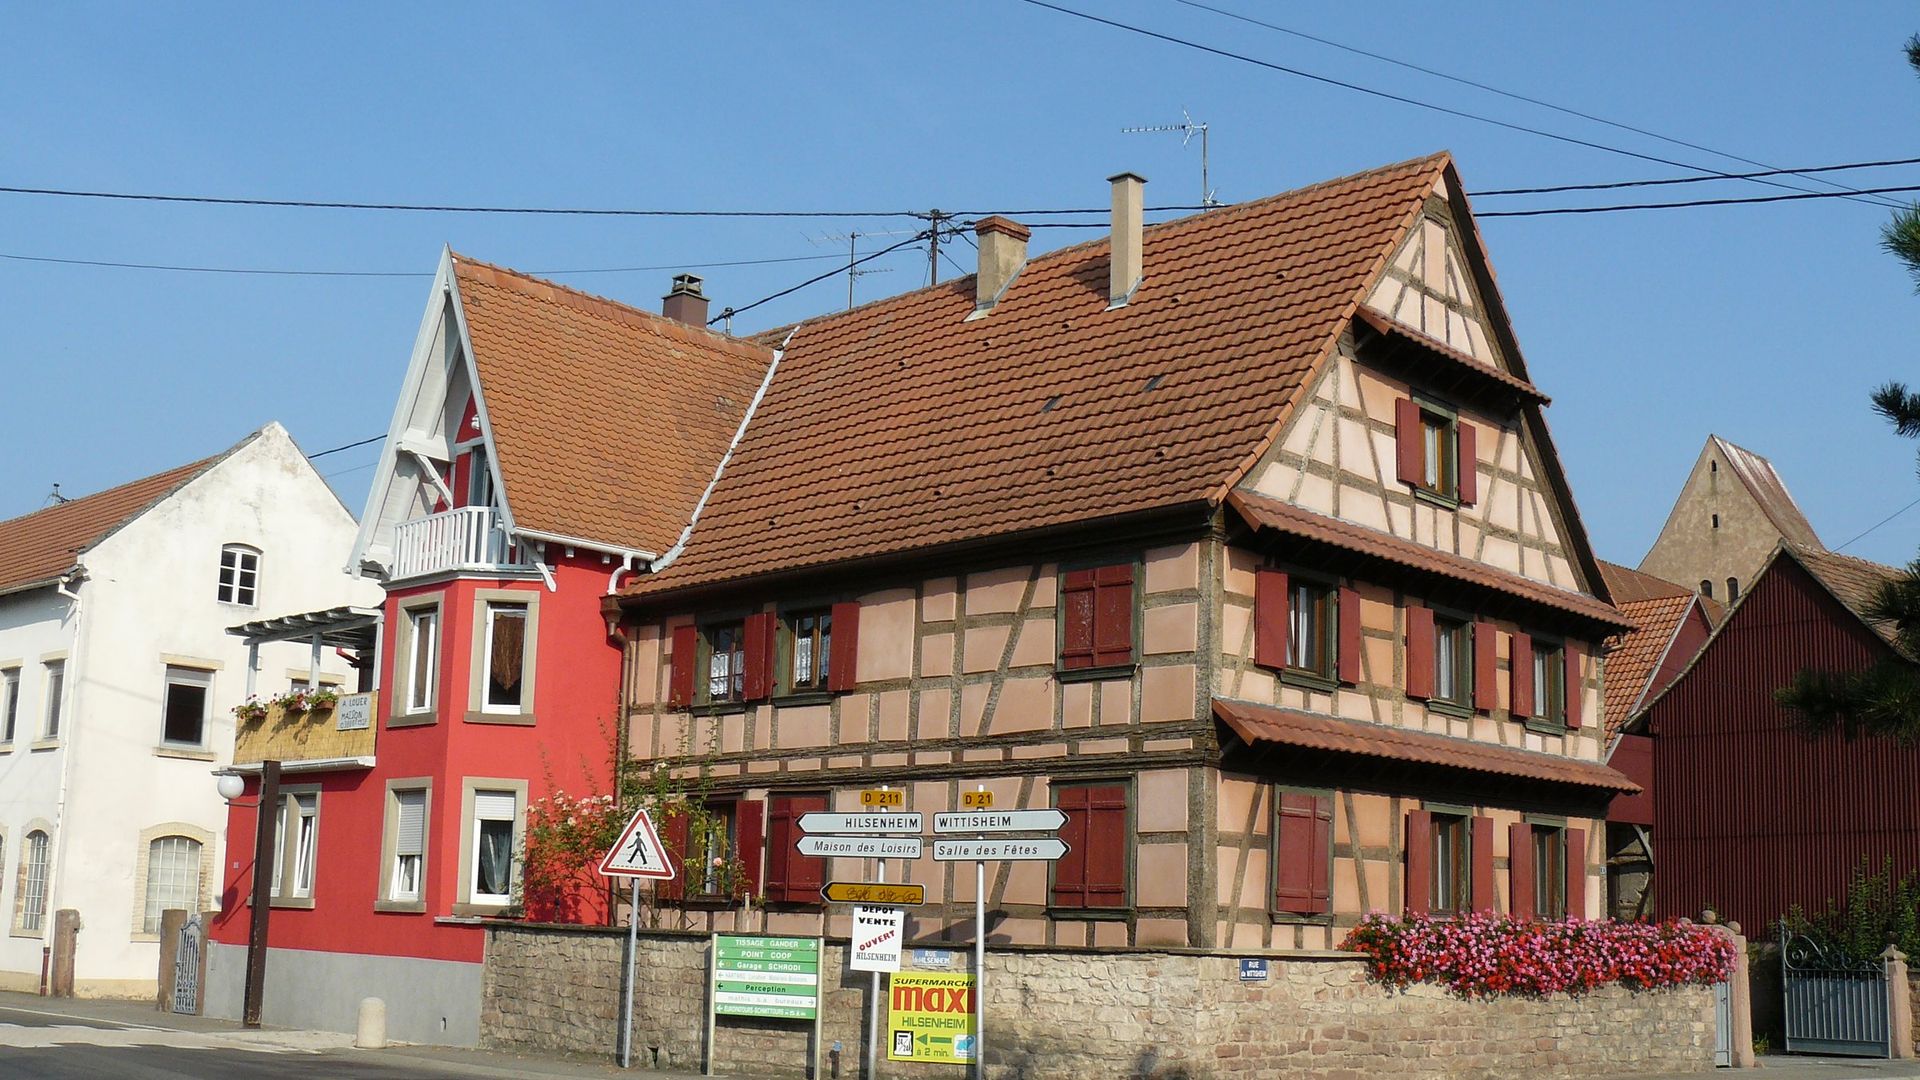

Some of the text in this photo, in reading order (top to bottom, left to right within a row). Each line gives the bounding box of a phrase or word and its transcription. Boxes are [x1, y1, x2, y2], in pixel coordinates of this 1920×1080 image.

[865, 793, 899, 803] D 211
[965, 794, 991, 805] D 21
[845, 817, 918, 828] HILSENHEIM
[939, 816, 1011, 827] WITTISHEIM
[814, 841, 917, 854] Maison des Loisirs
[938, 844, 1038, 856] Salle des Fêtes
[862, 906, 895, 915] DEPOT
[858, 917, 896, 926] VENTE
[736, 939, 799, 948] TISSAGE GANDER
[859, 930, 895, 951] OUVERT
[741, 950, 792, 959] POINT COOP
[856, 952, 897, 962] HILSENHEIM
[737, 961, 762, 970] Garage
[745, 984, 786, 993] Perception
[902, 1016, 966, 1029] HILSENHEIM
[924, 1047, 930, 1056] 2
[933, 1049, 949, 1057] min.
